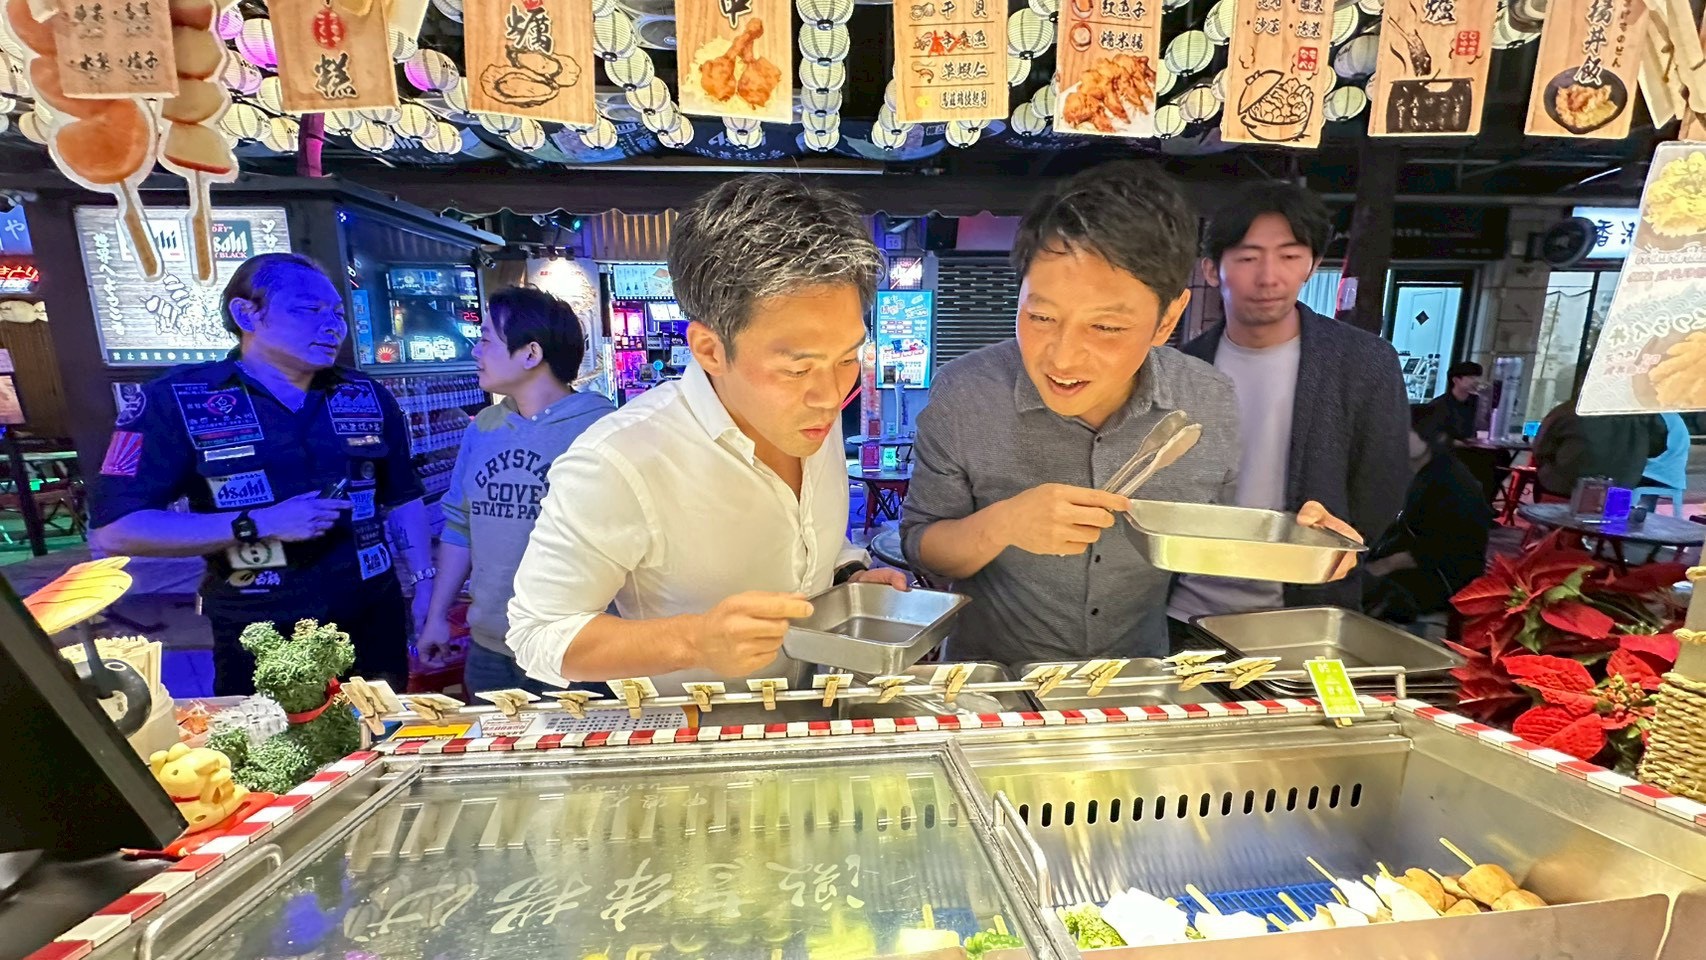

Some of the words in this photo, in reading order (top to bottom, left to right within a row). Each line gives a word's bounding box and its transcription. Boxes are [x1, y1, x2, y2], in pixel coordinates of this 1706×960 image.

[212, 230, 248, 252] sahi
[463, 311, 480, 322] 25
[217, 478, 267, 500] Asahi
[487, 482, 543, 505] COVE
[471, 501, 515, 519] STATE
[517, 504, 543, 520] PA
